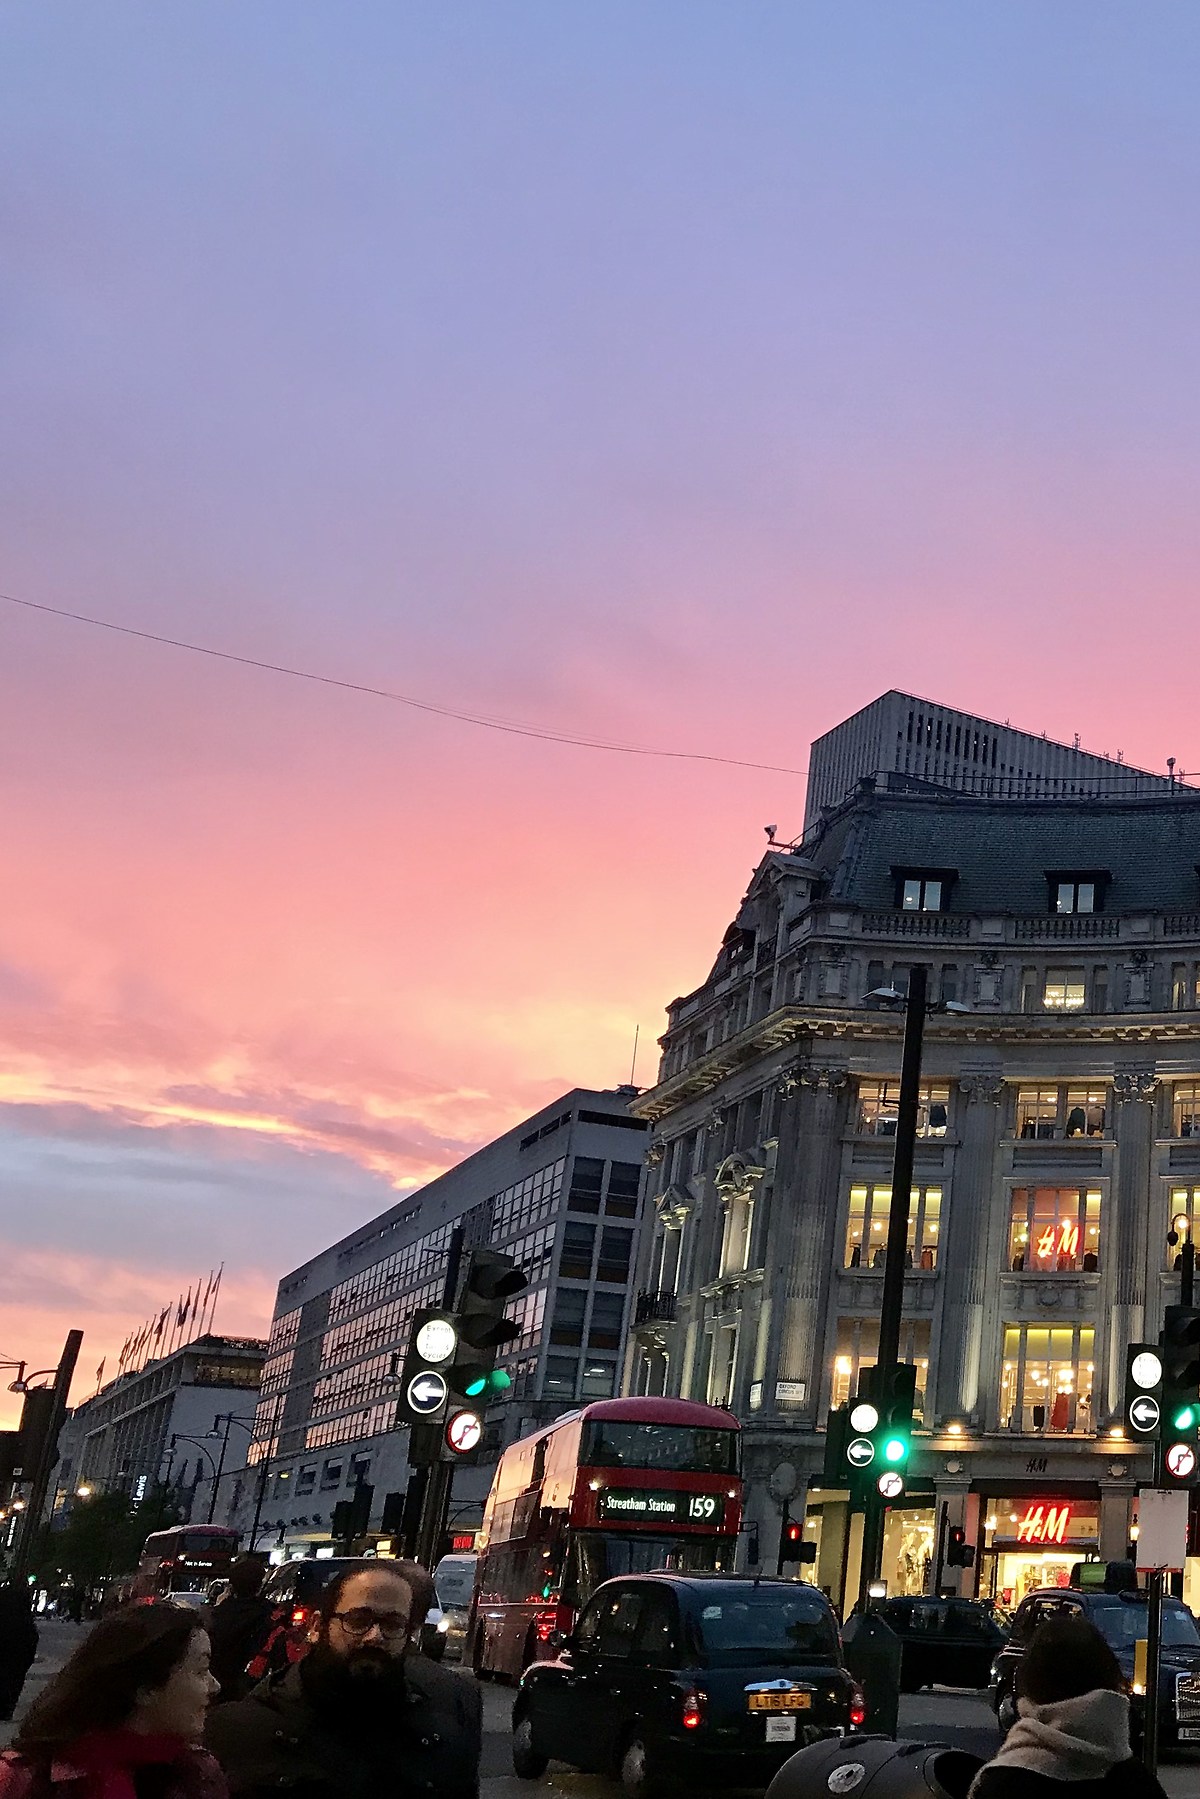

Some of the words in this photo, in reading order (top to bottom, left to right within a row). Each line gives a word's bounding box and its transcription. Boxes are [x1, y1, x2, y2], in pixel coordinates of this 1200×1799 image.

[132, 1475, 148, 1501] Lewis
[606, 1496, 647, 1510] Streatham
[648, 1499, 676, 1512] Station
[689, 1498, 716, 1517] 159
[1017, 1506, 1070, 1543] H&M
